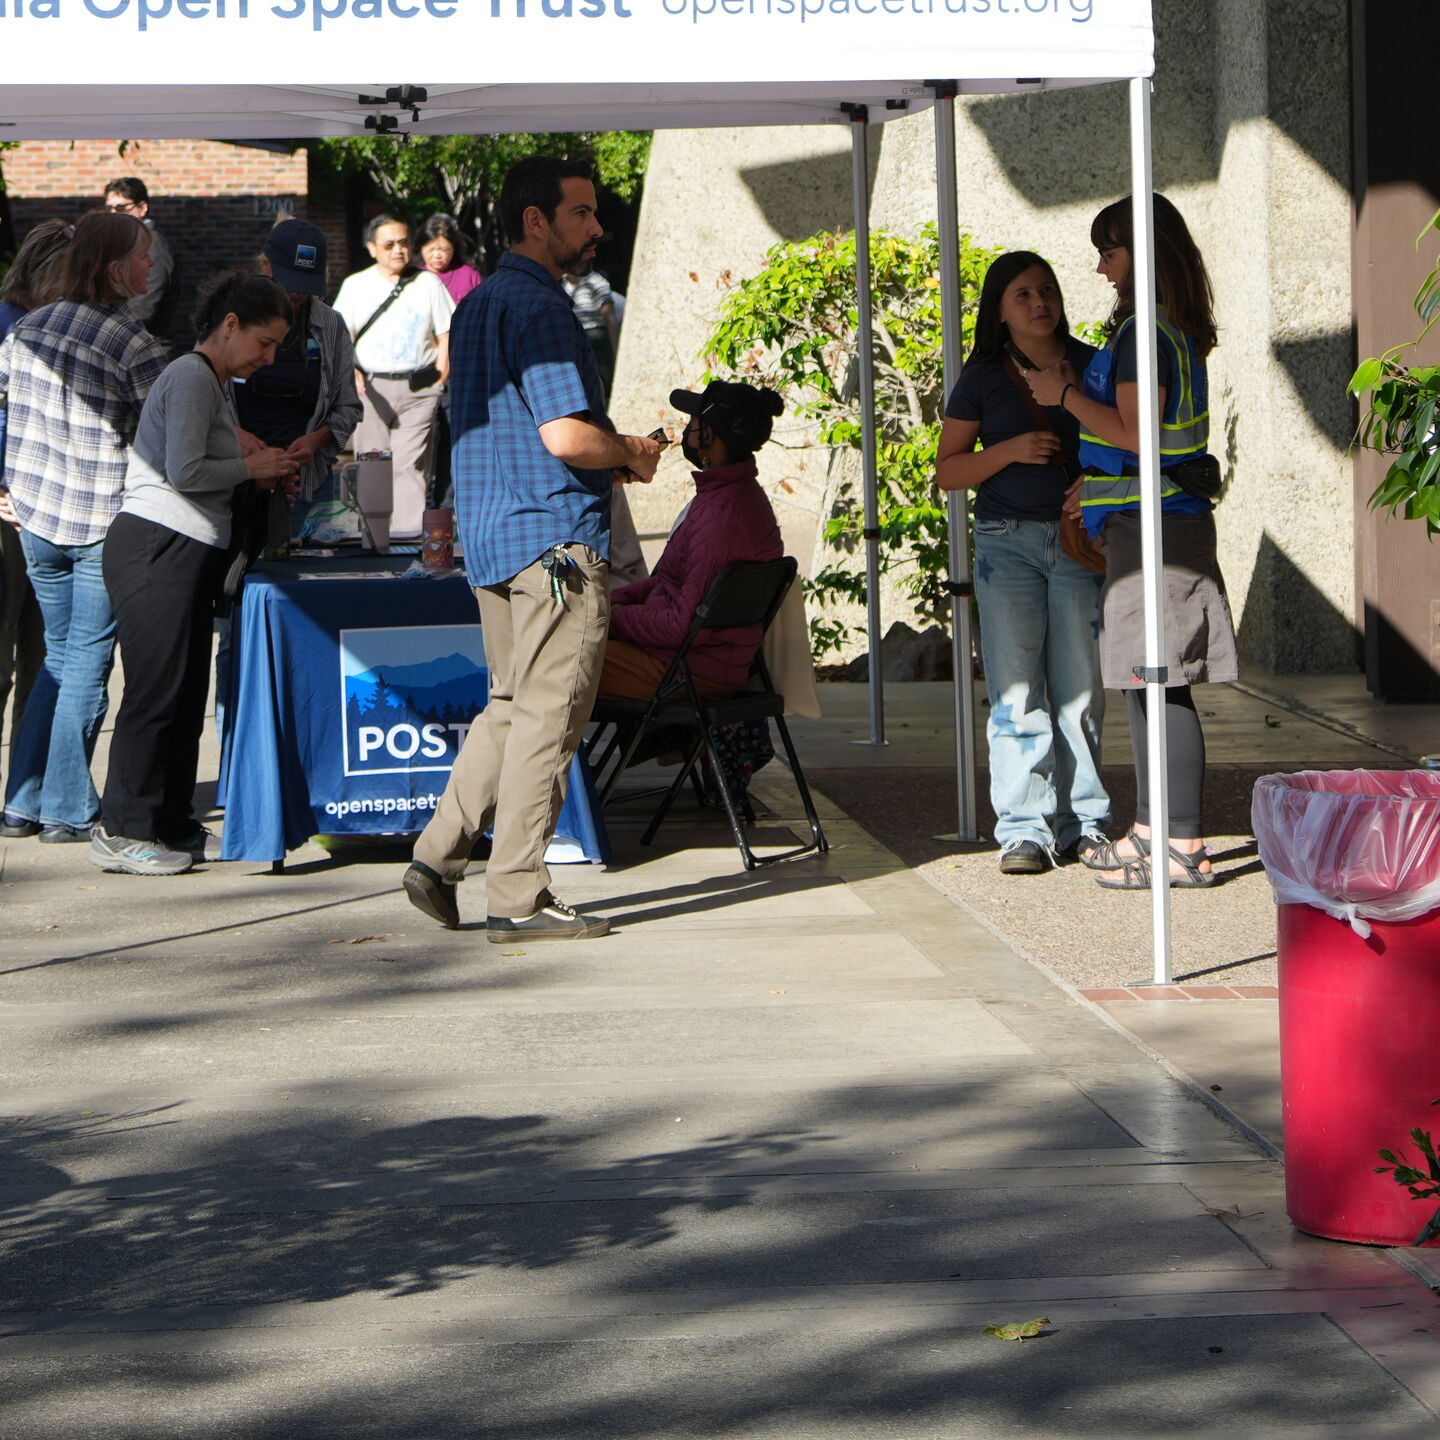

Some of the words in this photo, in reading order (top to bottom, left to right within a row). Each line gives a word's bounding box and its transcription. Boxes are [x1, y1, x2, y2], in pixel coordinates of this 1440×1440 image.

[297, 258, 313, 266] POST
[358, 723, 472, 761] POST
[325, 793, 442, 819] openspacet
